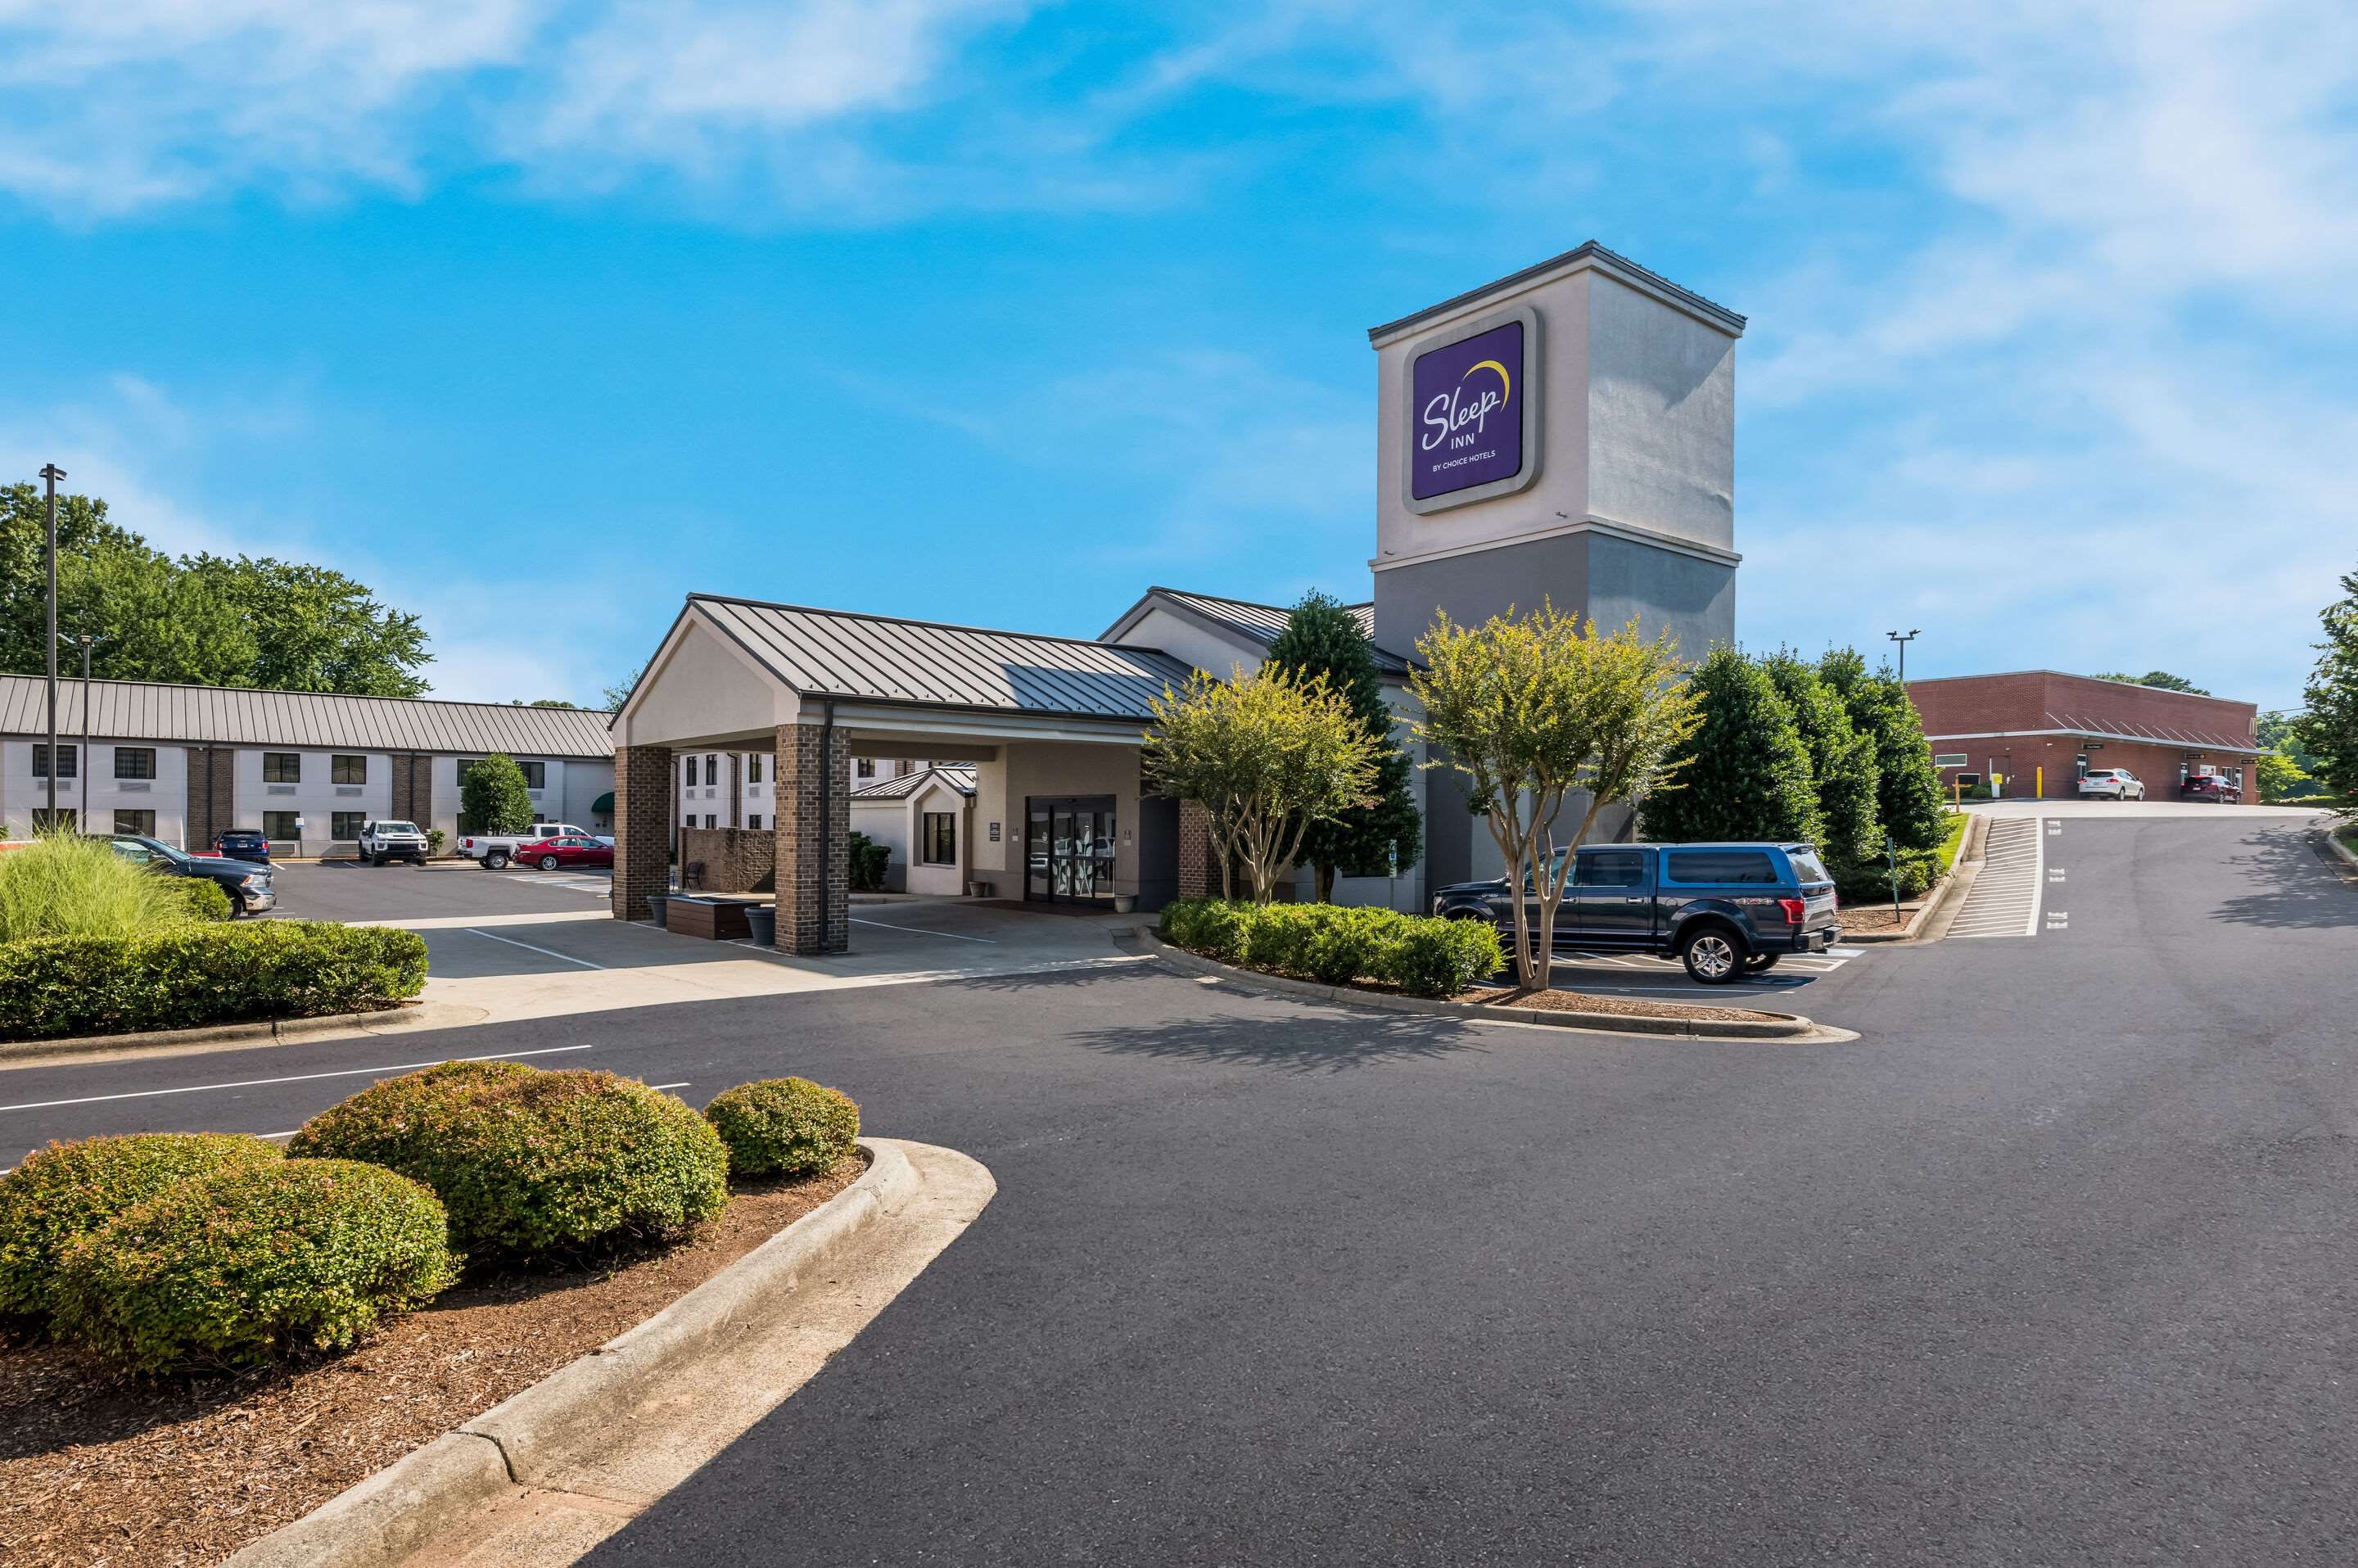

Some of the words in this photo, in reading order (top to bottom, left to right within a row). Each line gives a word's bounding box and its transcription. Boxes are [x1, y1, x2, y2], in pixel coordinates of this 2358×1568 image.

[1421, 386, 1501, 450] Sleep
[1451, 432, 1475, 450] INN
[1433, 463, 1442, 472] BY
[1443, 457, 1468, 470] CHOICE
[1469, 450, 1496, 463] HOTELS
